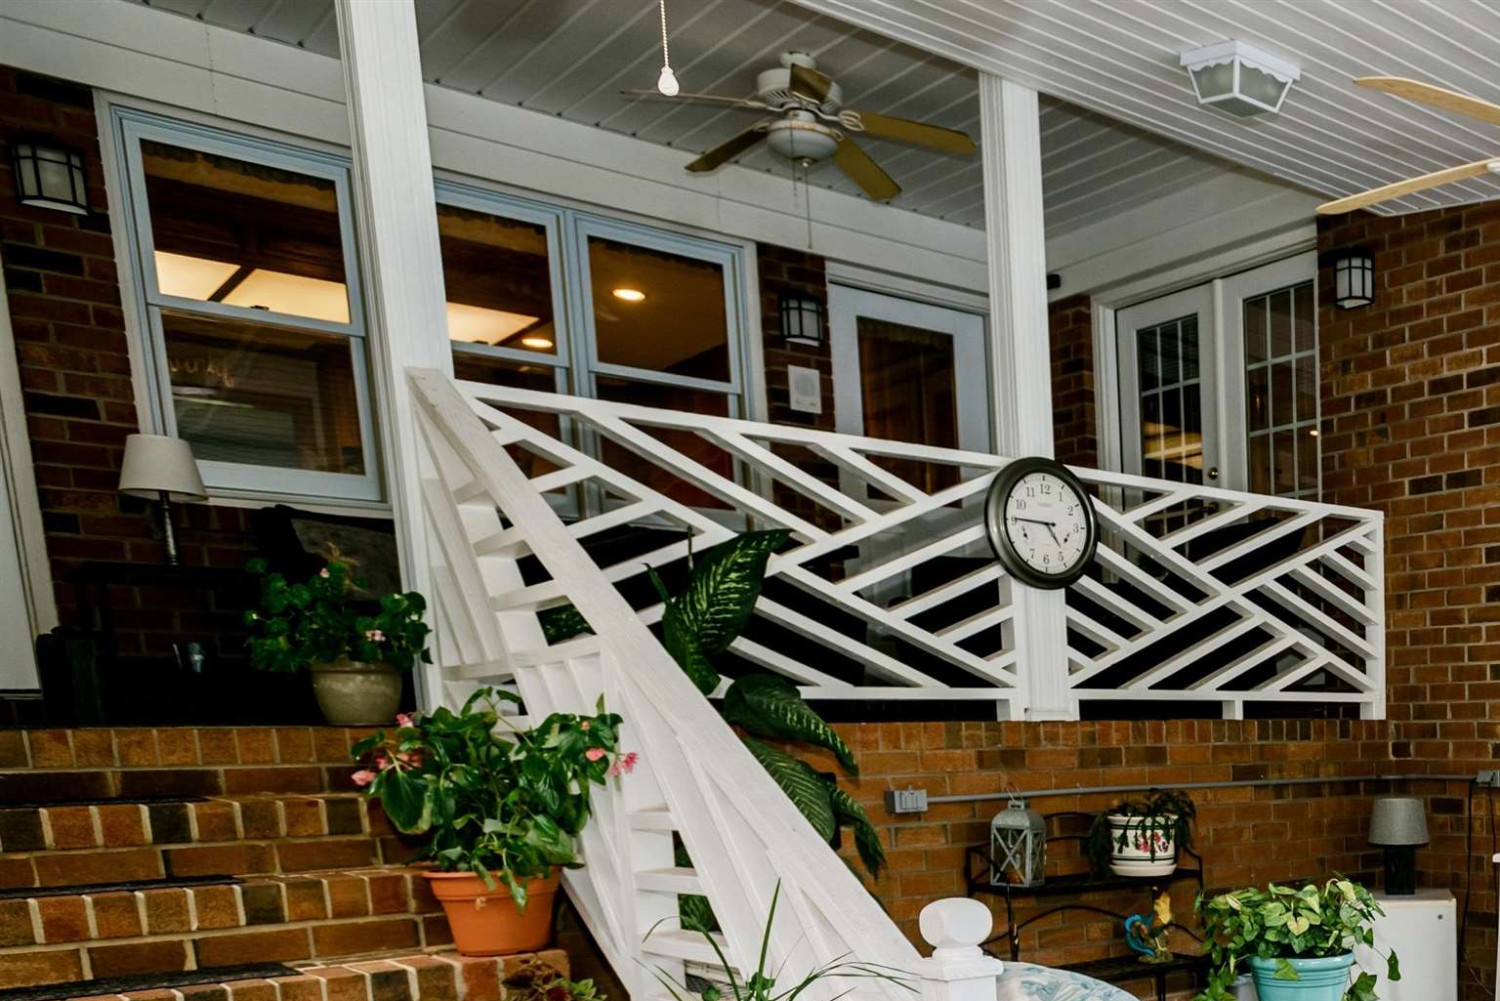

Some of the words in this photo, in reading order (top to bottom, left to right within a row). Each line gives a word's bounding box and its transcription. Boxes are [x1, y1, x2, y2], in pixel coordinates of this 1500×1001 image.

[1026, 486, 1035, 498] 11
[1040, 483, 1051, 495] 12
[1058, 491, 1063, 502] 1
[1016, 499, 1026, 510] 10
[1067, 505, 1074, 517] 2
[1011, 515, 1018, 526] 9
[1072, 522, 1079, 533] 3
[1029, 548, 1035, 559] 7
[1058, 551, 1064, 562] 5
[1043, 554, 1050, 565] 6
